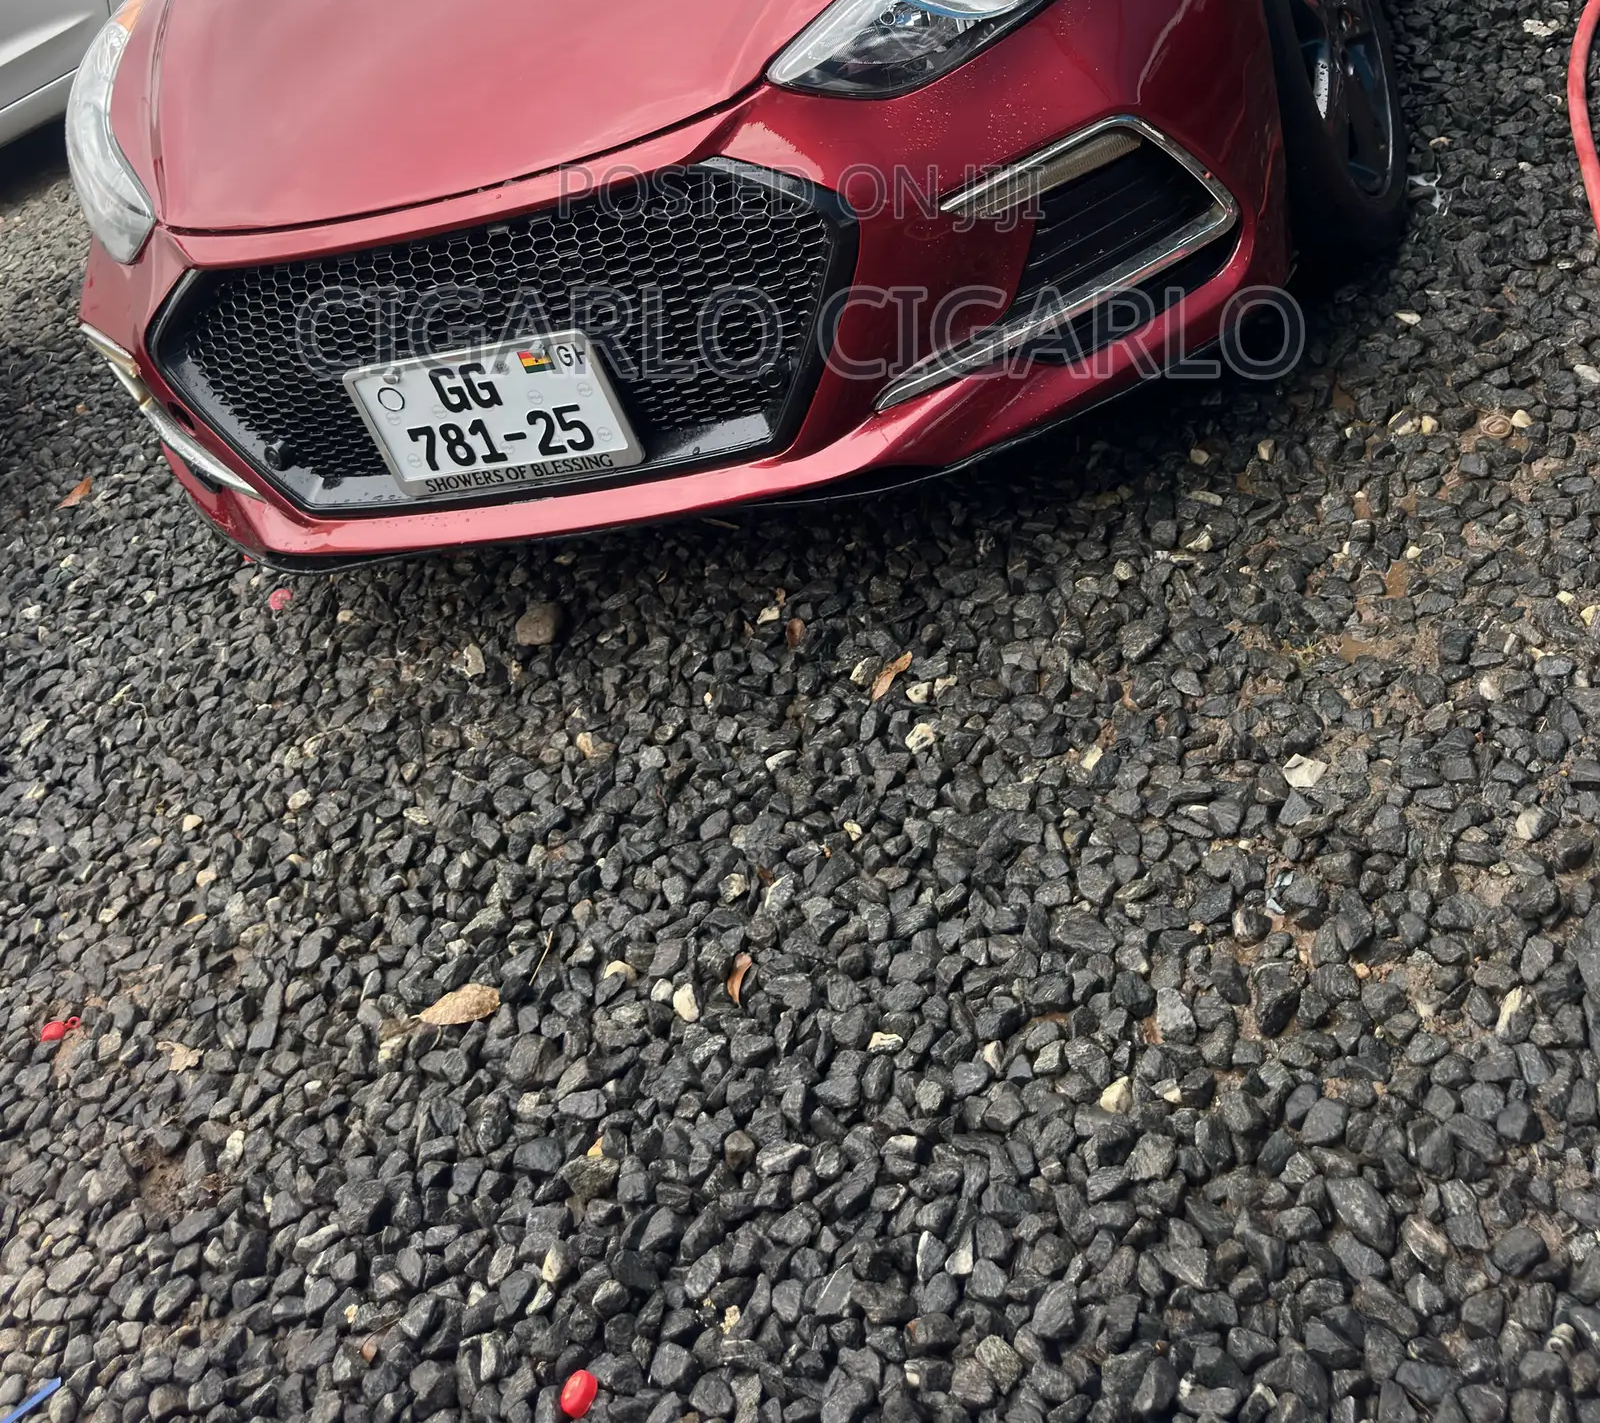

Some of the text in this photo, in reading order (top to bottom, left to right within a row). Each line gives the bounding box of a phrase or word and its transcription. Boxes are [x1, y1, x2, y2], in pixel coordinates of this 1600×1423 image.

[428, 362, 503, 413] GG
[406, 404, 595, 472] 781-25
[425, 453, 614, 493] SHOWERS OF BLESSING
